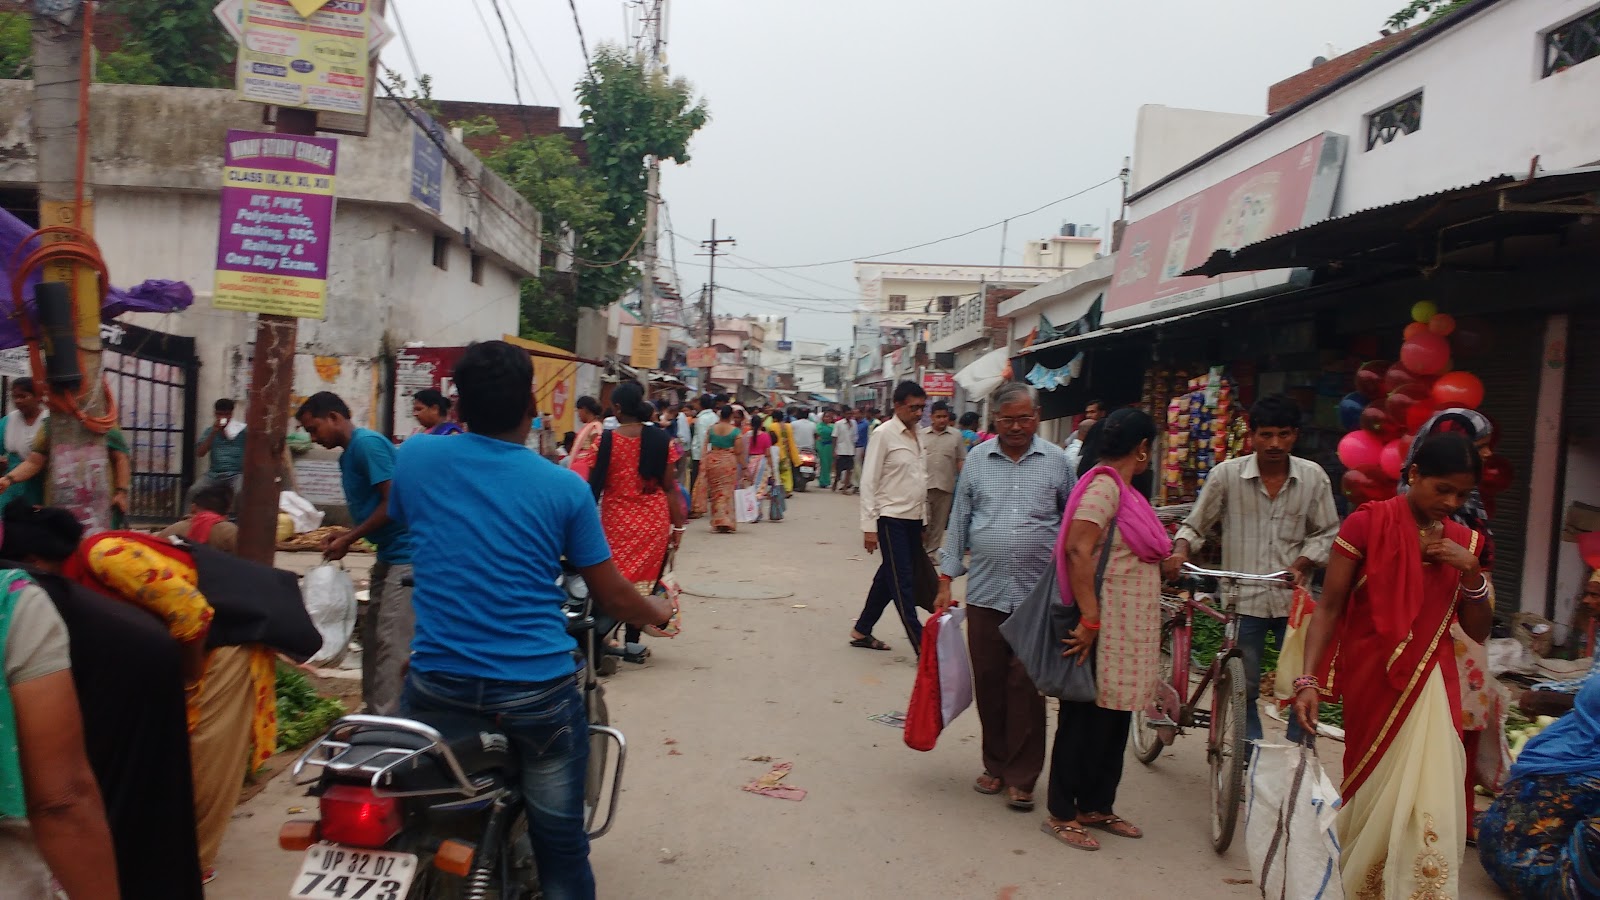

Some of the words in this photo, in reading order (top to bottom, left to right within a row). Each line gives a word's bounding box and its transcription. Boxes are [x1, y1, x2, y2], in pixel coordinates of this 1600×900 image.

[229, 170, 262, 183] CLASS
[235, 208, 314, 229] Polytechnic,
[230, 222, 286, 241] Banking,
[287, 227, 318, 244] SSC,
[241, 238, 292, 257] Railway
[293, 243, 305, 255] &
[225, 252, 251, 266] One
[252, 254, 279, 270] Day
[322, 850, 345, 871] UP
[348, 853, 371, 874] 32
[373, 856, 396, 877] DZ
[298, 872, 401, 900] 7473
